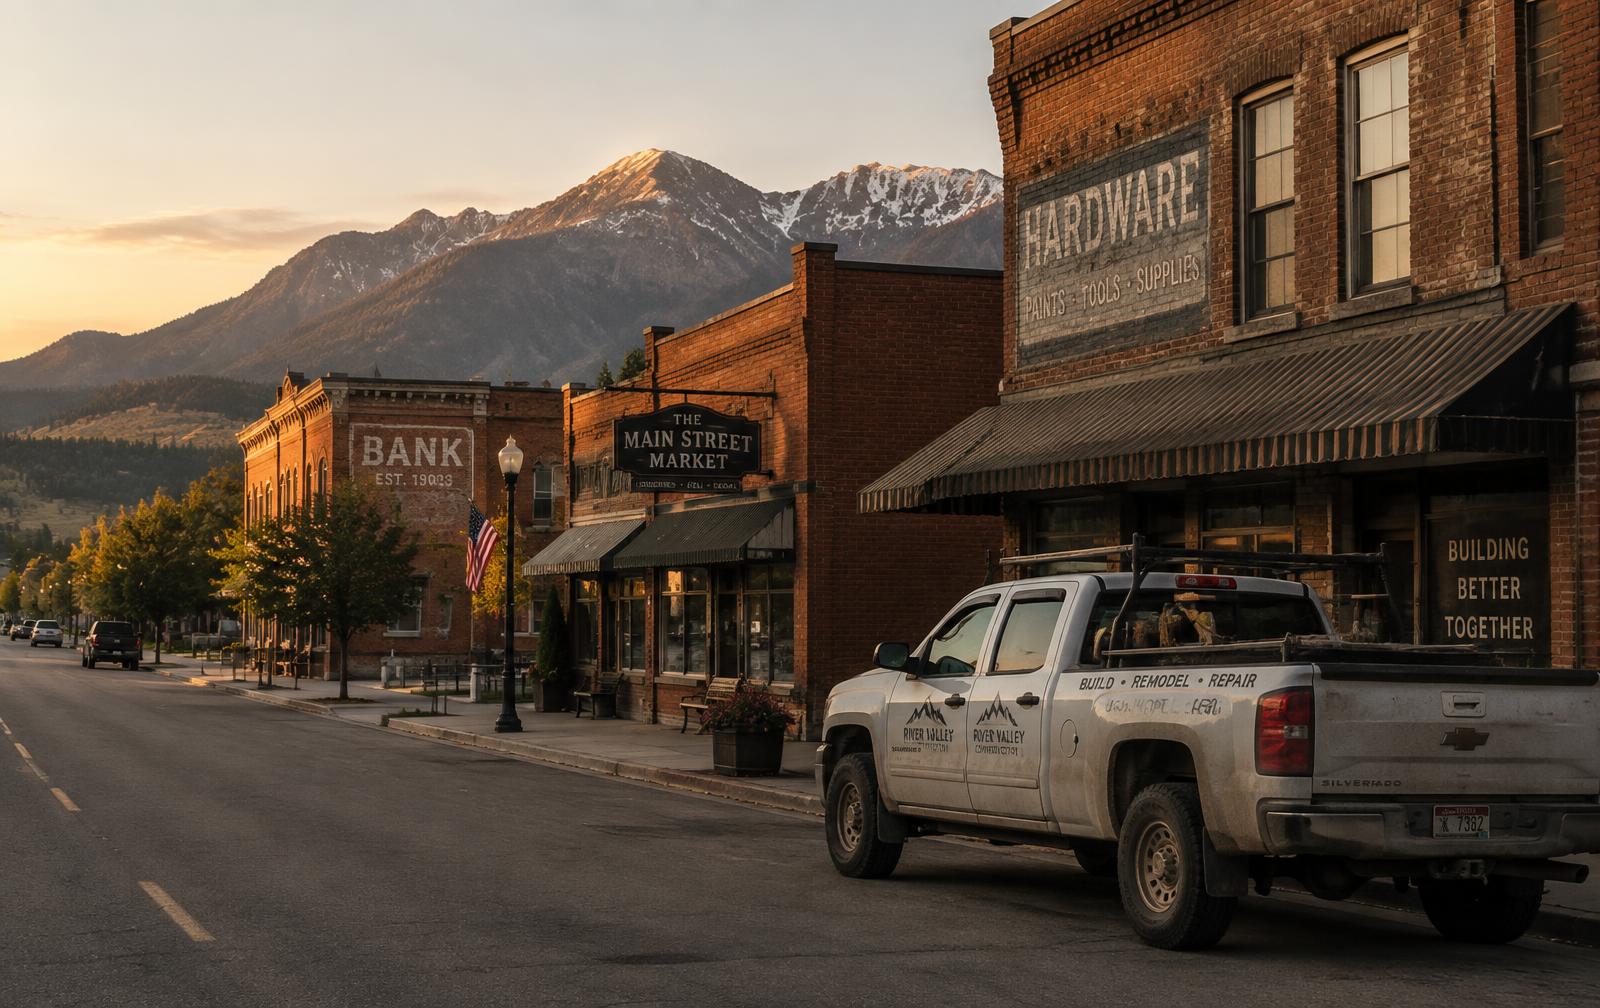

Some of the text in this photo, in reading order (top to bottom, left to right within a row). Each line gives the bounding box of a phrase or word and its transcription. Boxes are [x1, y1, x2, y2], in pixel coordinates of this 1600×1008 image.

[1024, 150, 1199, 270] HARDWARE
[1025, 253, 1200, 322] PAINTS TOOLS SUPPLIES
[673, 413, 702, 426] THE
[361, 435, 464, 467] BANK
[624, 430, 753, 453] MAIN STREET
[650, 453, 729, 469] MARKET
[375, 473, 407, 486] EST.
[1448, 537, 1529, 561] BUILDING
[1457, 576, 1521, 600] BETTER
[1444, 615, 1534, 640] TOGETHER
[1079, 673, 1258, 691] BUILD REMODEL REPAIR
[996, 729, 1025, 744] VALLEY
[1321, 779, 1402, 787] SILVERADO
